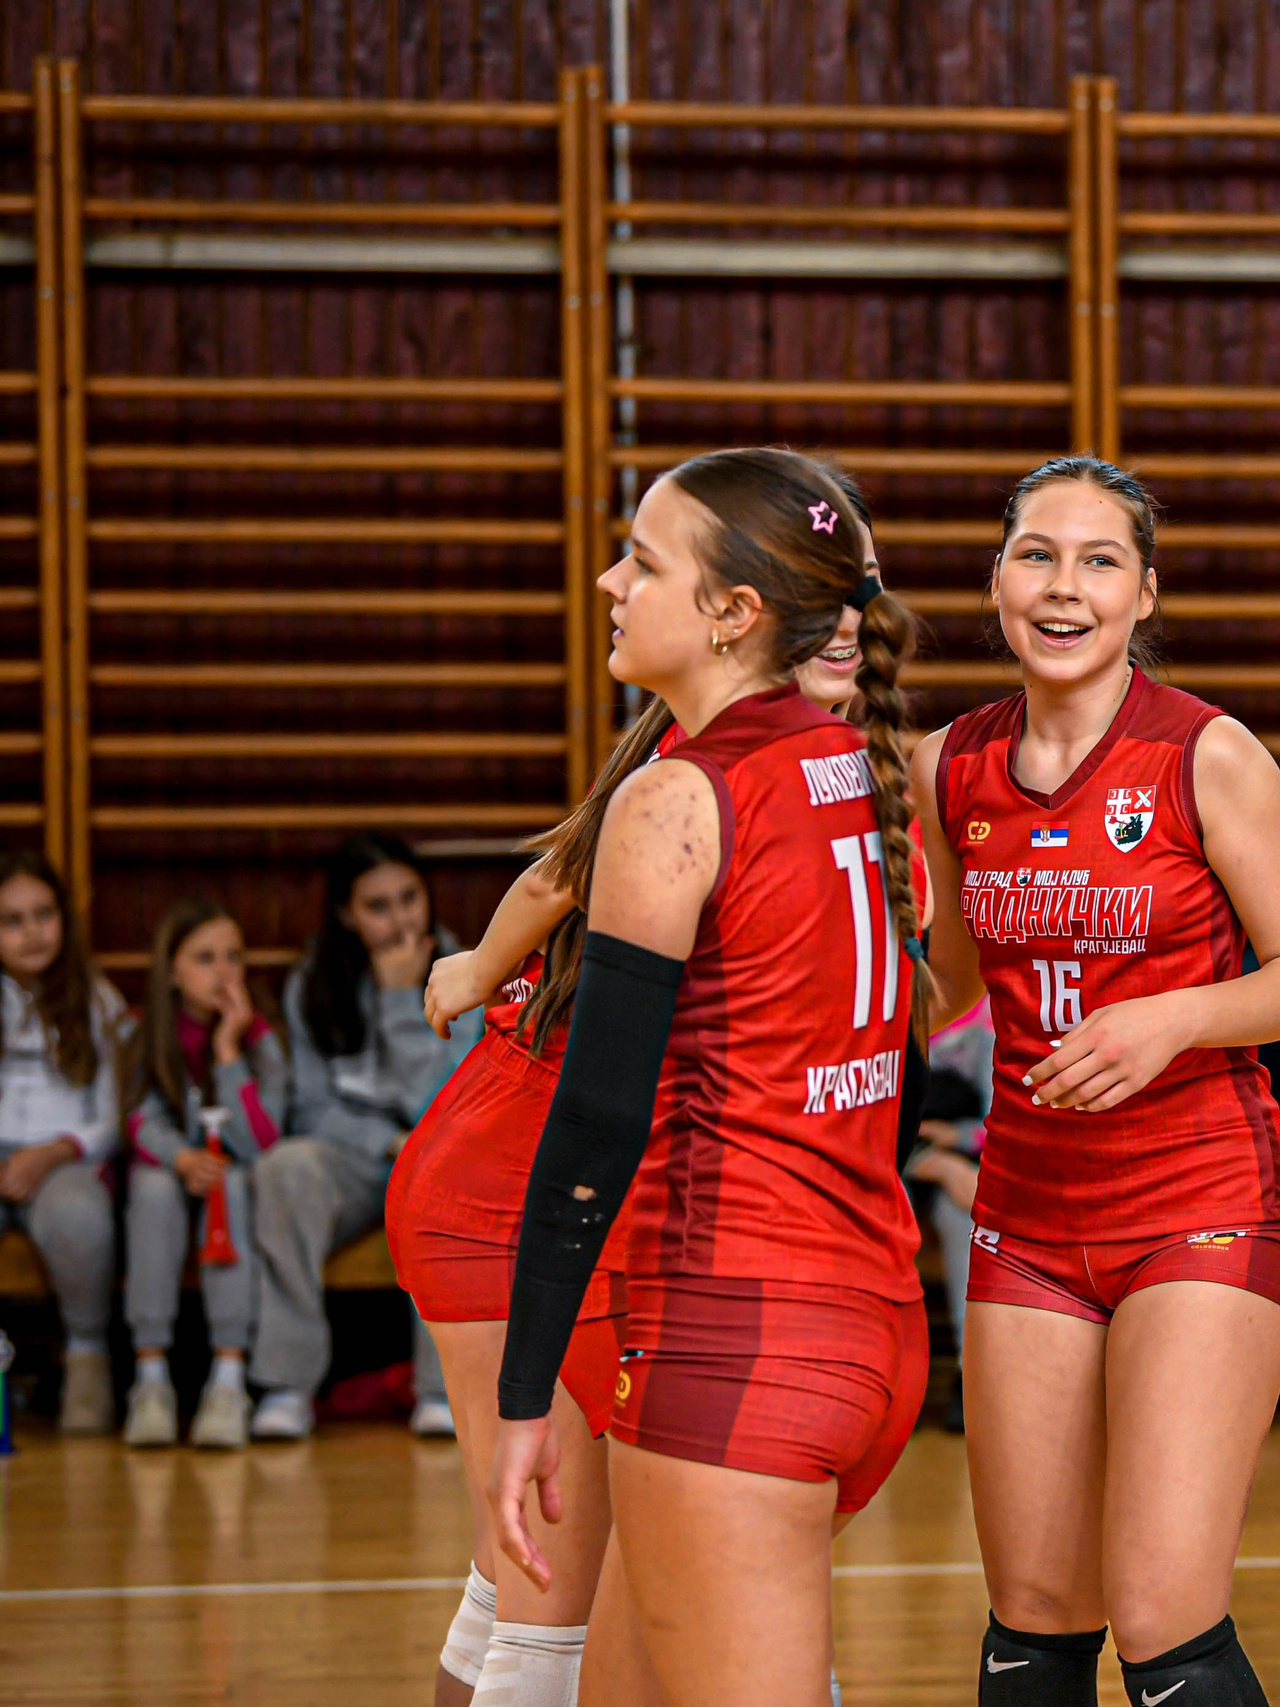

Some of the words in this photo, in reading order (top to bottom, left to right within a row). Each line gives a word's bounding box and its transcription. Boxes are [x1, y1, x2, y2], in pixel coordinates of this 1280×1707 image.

[982, 871, 1014, 888] ГРАД
[1033, 870, 1060, 886] МОЈ
[1060, 869, 1091, 886] КЛУБ
[830, 831, 899, 1029] 11
[960, 886, 1153, 944] РАДНИЧКИ
[1073, 938, 1146, 954] КРАГУЈЕВАЦ
[1032, 958, 1083, 1032] 16
